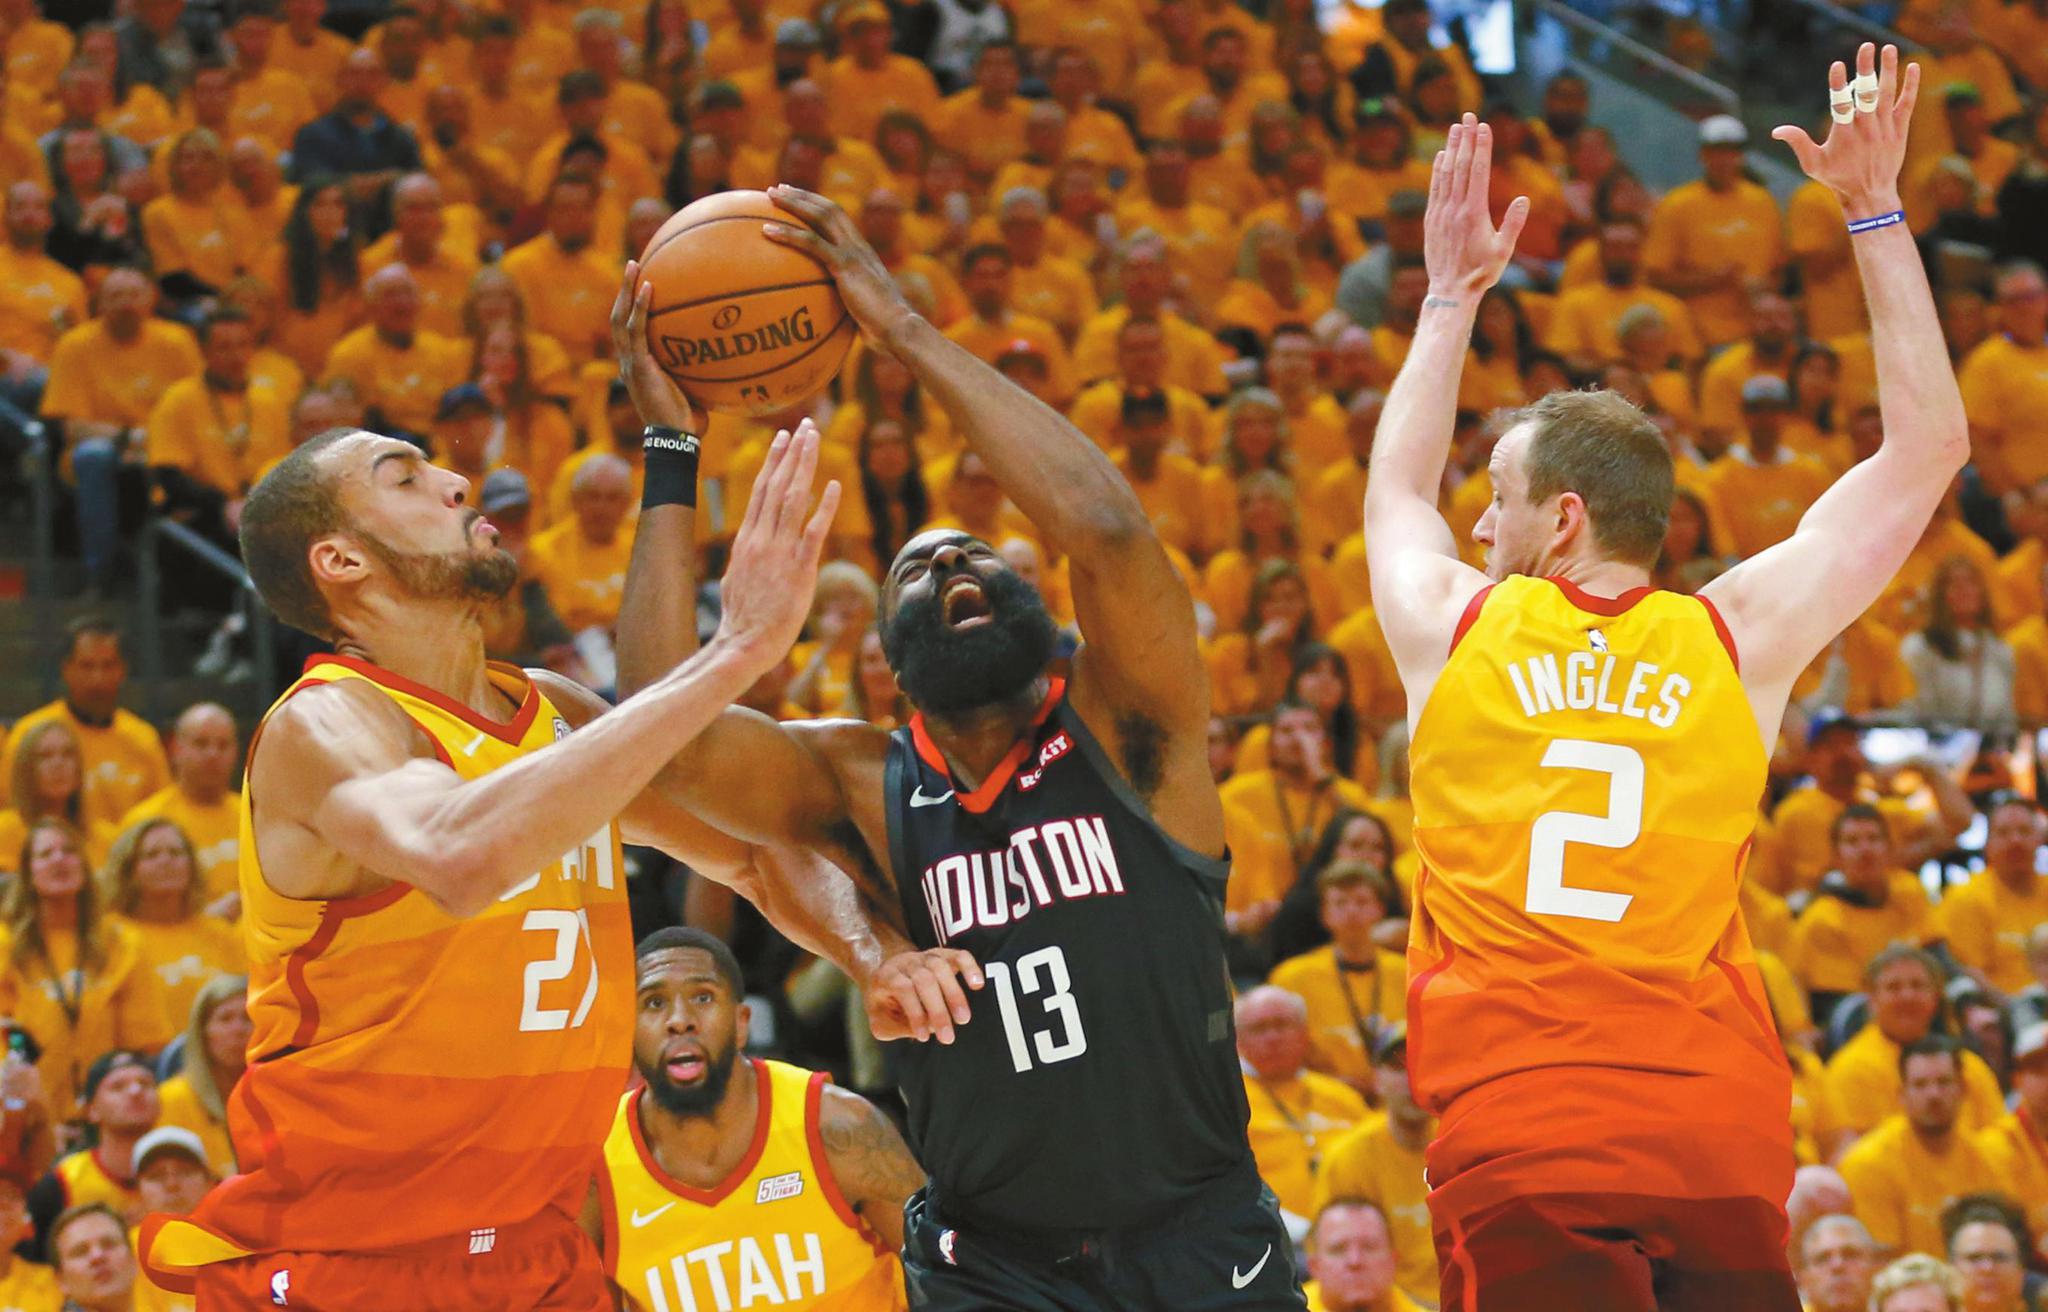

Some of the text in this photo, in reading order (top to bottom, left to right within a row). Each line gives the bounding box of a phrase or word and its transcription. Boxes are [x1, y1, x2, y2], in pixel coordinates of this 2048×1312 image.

[660, 306, 816, 368] SPALDING
[654, 436, 696, 453] ENOUGH
[1508, 651, 1692, 728] INGLES
[1526, 740, 1645, 922] 2
[921, 816, 1125, 948] HOUSTON
[984, 945, 1088, 1074] 13
[759, 1180, 771, 1200] 5
[645, 1233, 826, 1312] UTAH
